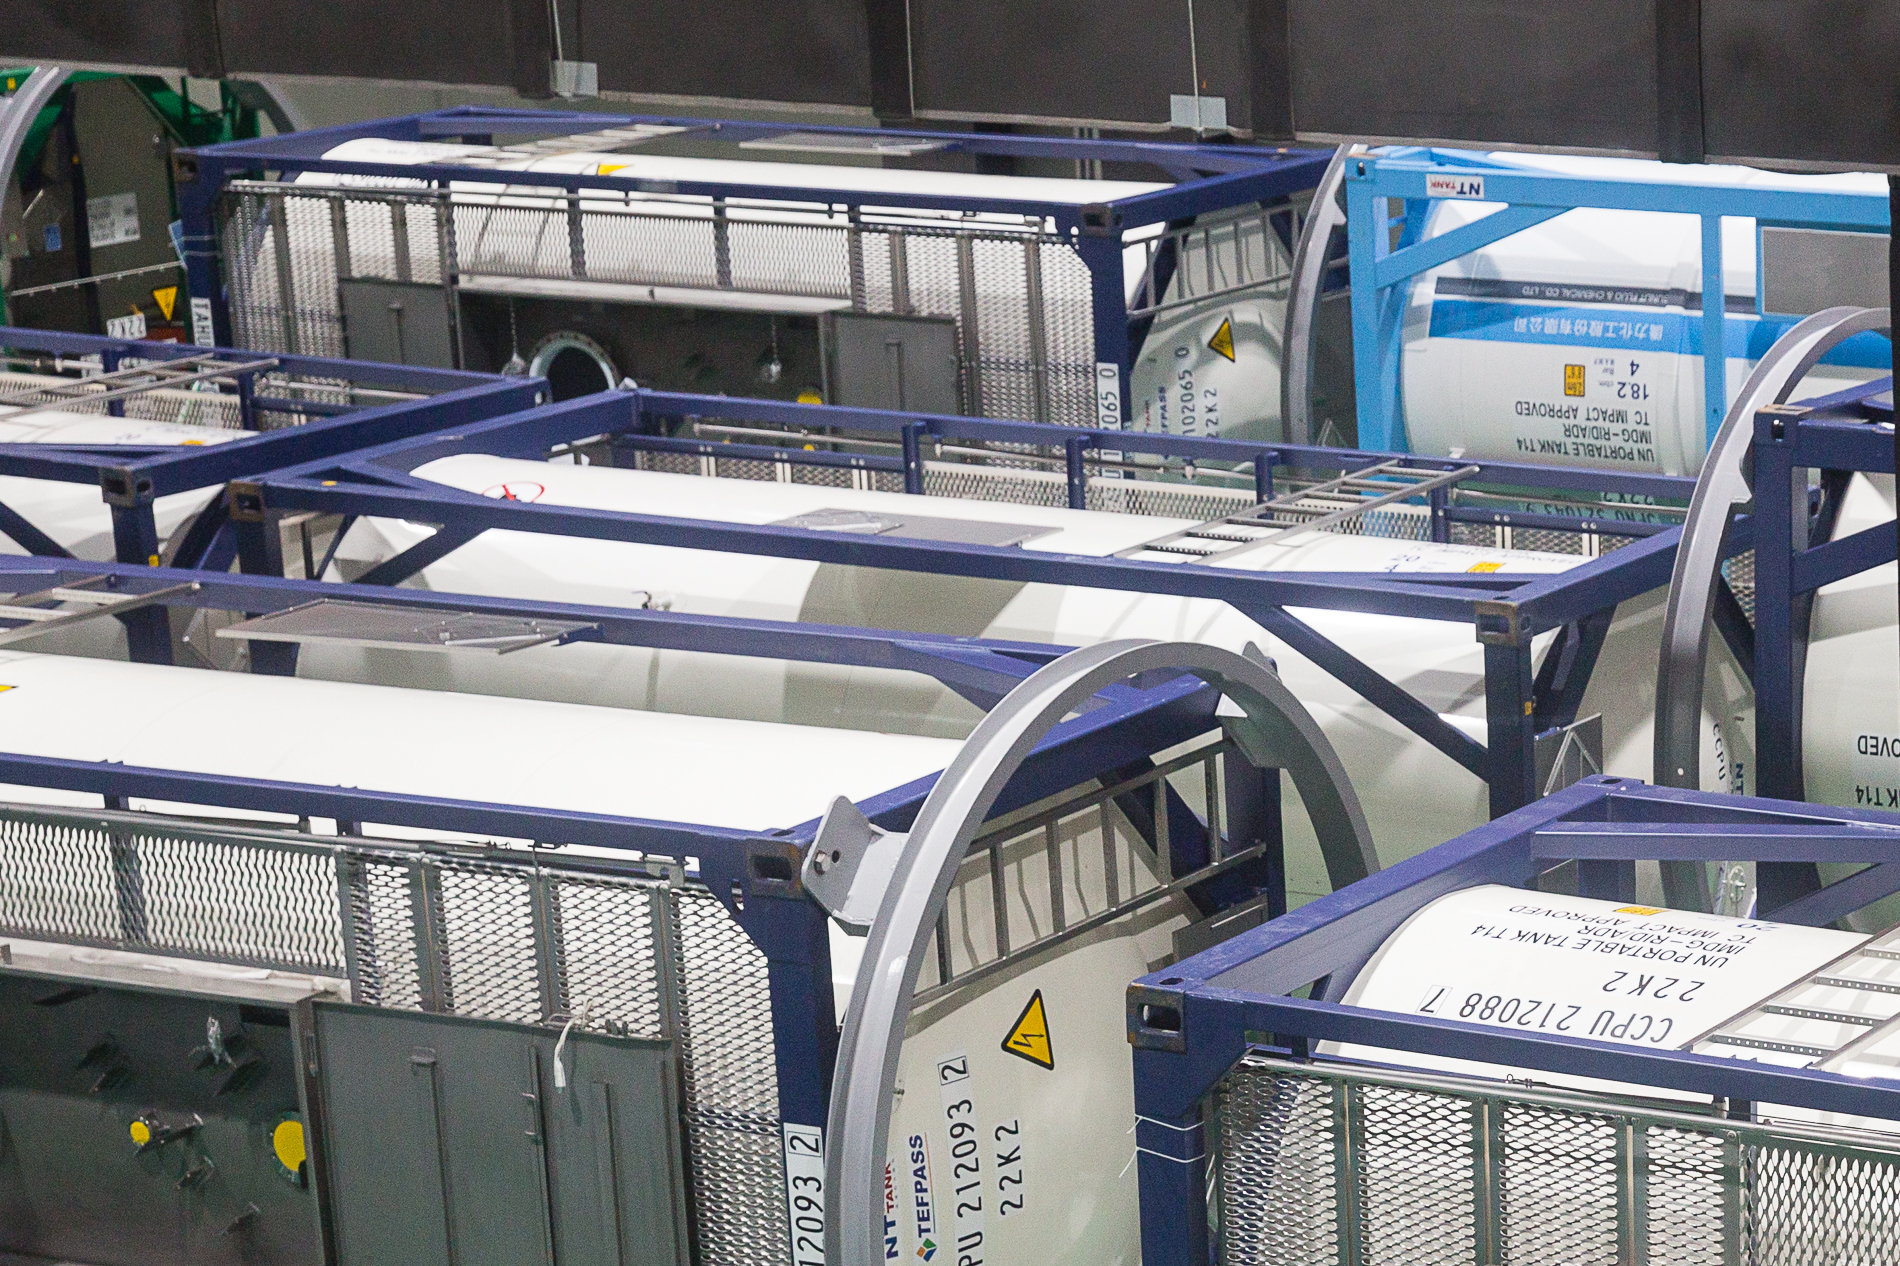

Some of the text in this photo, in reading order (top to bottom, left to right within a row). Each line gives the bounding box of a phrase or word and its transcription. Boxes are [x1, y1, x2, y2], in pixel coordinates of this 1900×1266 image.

[1457, 182, 1480, 195] NT
[1174, 347, 1190, 358] 0
[1100, 368, 1117, 379] 0
[1630, 359, 1640, 376] 4
[1617, 381, 1650, 400] 18.2
[1515, 401, 1650, 426] TC IMPACT APPROVED
[1517, 437, 1655, 462] UN PORTABLE TANK T14
[1713, 723, 1726, 780] CCPU
[1856, 785, 1883, 806] T14
[1509, 905, 1632, 926] APPROVED
[1635, 922, 1720, 938] IMPACT
[1726, 934, 1757, 944] TC
[1470, 924, 1729, 968] UN PORTABLE TANK T14
[1602, 971, 1705, 1002] 22K2
[1420, 988, 1673, 1043] CCPU 212088 7
[941, 1059, 967, 1081] 2
[789, 1135, 820, 1153] 2
[947, 1099, 983, 1218] 212093
[994, 1120, 1024, 1216] 22K2
[884, 1162, 894, 1214] TANK
[909, 1134, 931, 1238] TEFPASS
[884, 1215, 899, 1259] NT
